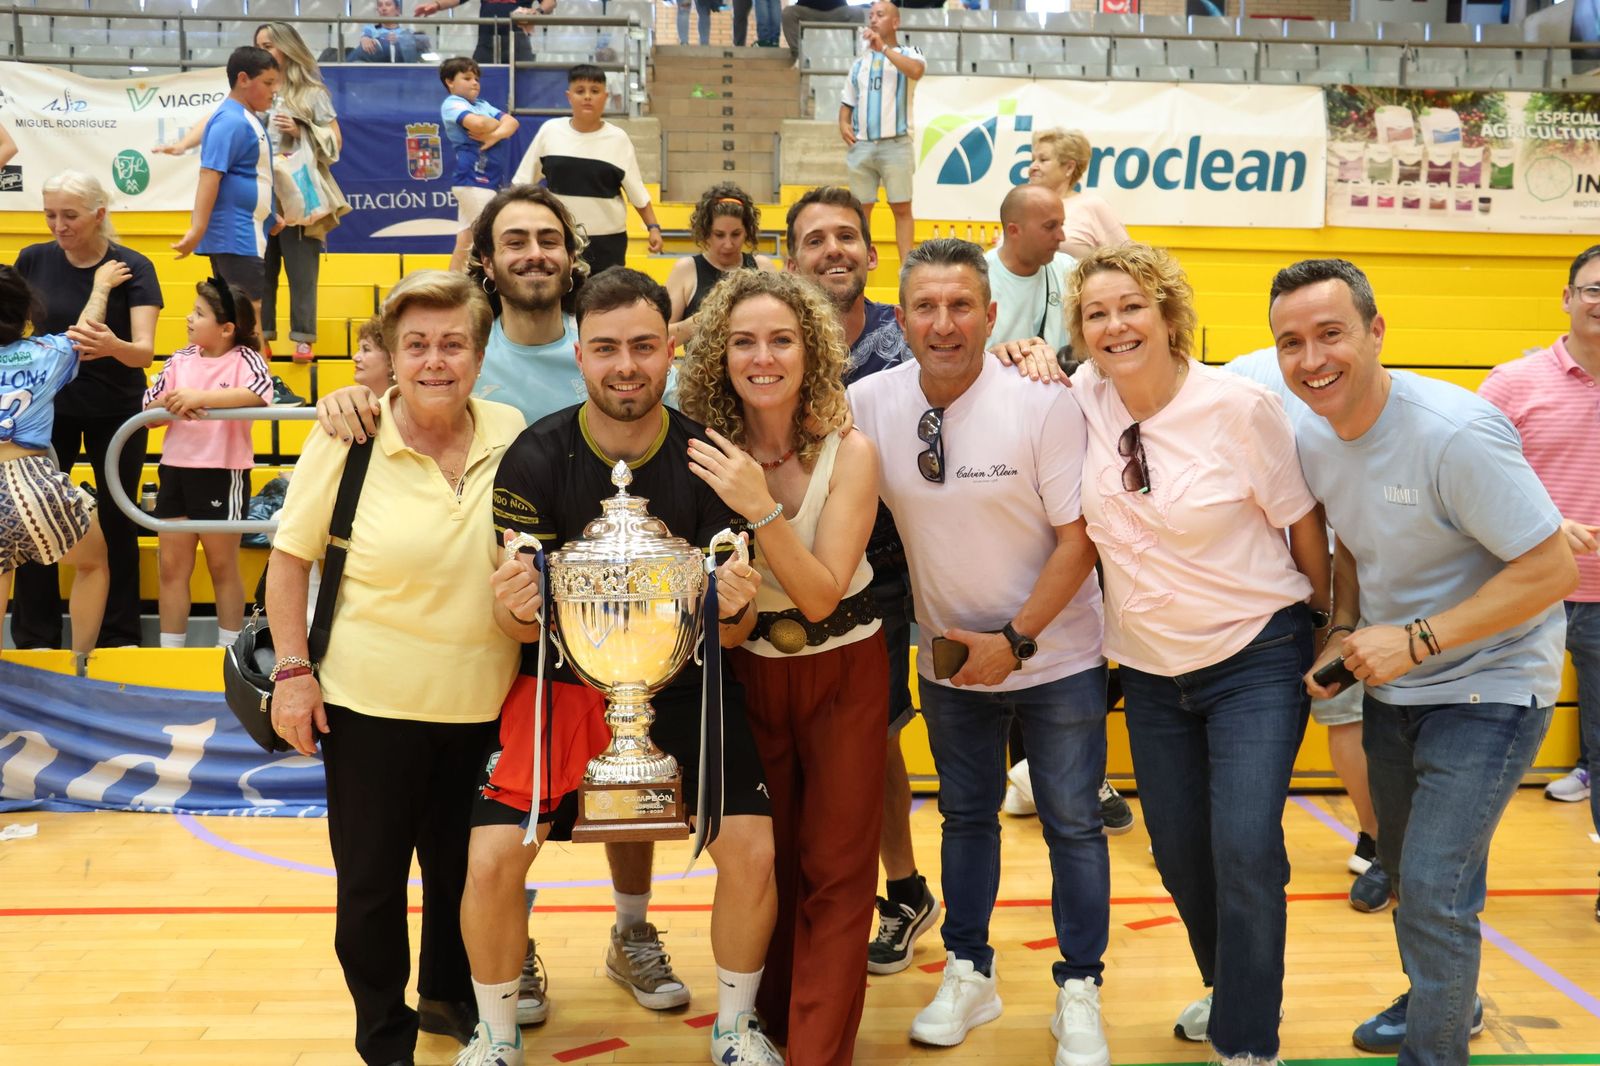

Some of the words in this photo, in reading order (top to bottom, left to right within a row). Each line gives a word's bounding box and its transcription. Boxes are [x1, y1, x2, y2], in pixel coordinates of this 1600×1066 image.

[158, 92, 225, 108] VIAGRO
[15, 119, 54, 128] MIGUEL
[56, 118, 117, 128] RODRÍGUEZ
[1535, 111, 1600, 125] ESPECIAL
[1009, 135, 1307, 193] aroclean
[432, 191, 458, 207] DE
[956, 466, 985, 479] Calvin
[987, 464, 1018, 477] Klein
